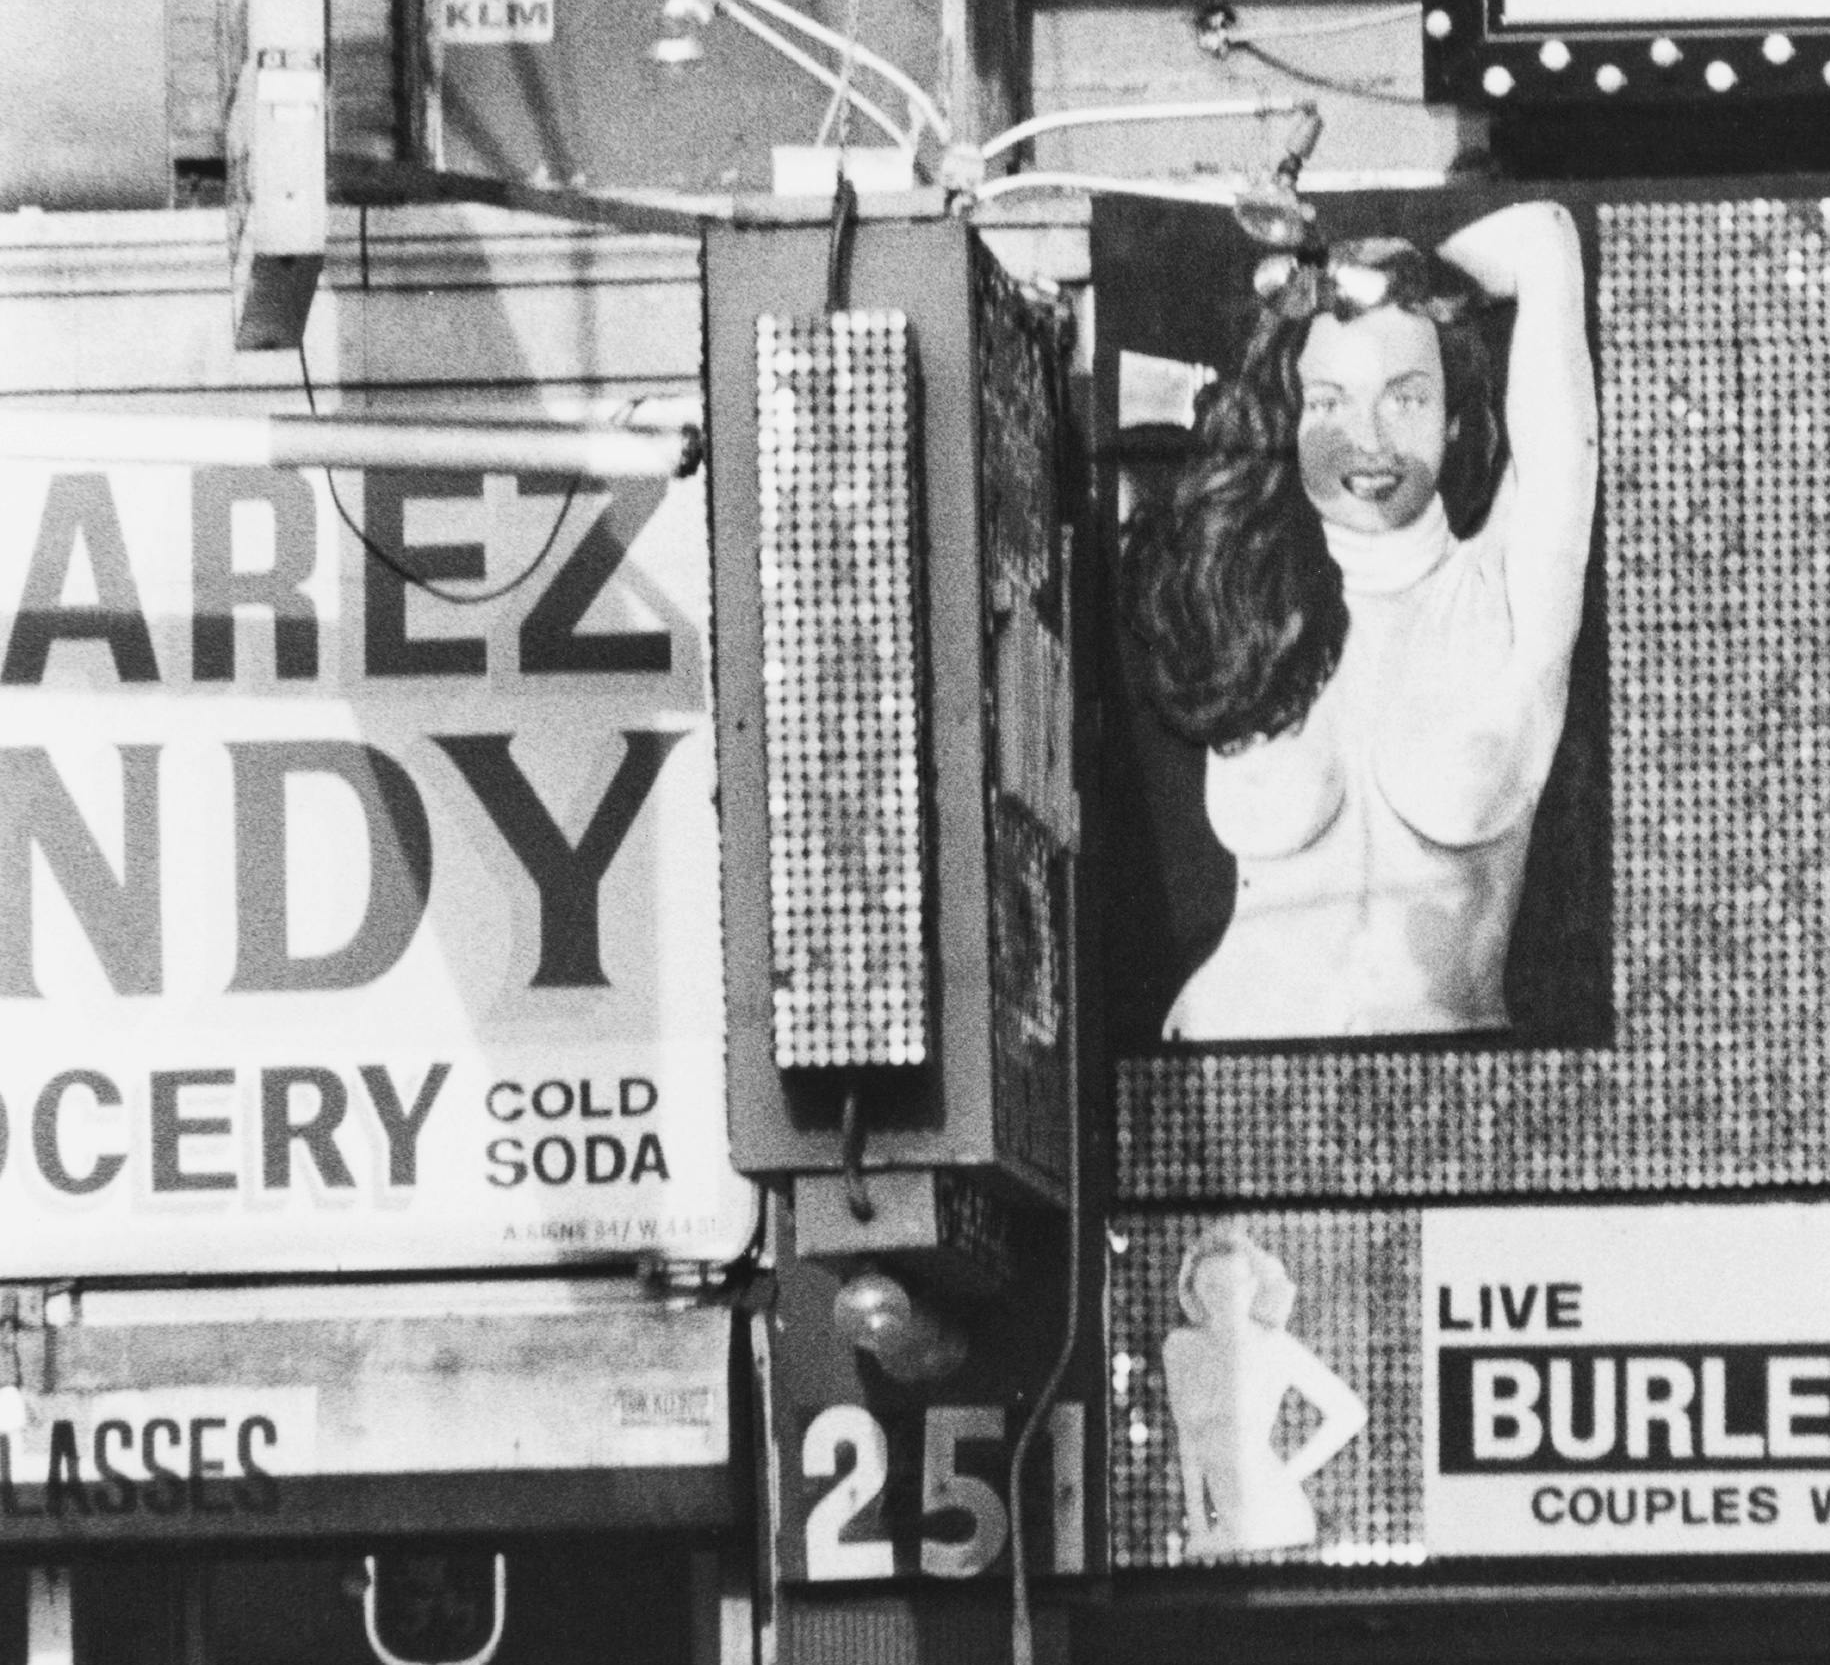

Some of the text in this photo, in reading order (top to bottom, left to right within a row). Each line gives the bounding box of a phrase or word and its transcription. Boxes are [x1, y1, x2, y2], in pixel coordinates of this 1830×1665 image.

[444, 0, 549, 29] KLM
[487, 1077, 659, 1122] COLD
[0, 1062, 453, 1196] CERY
[487, 1132, 670, 1186] SODA
[1438, 1282, 1582, 1331] LIVE
[800, 1401, 1086, 1581] 251
[1531, 1485, 1779, 1526] COUPLES
